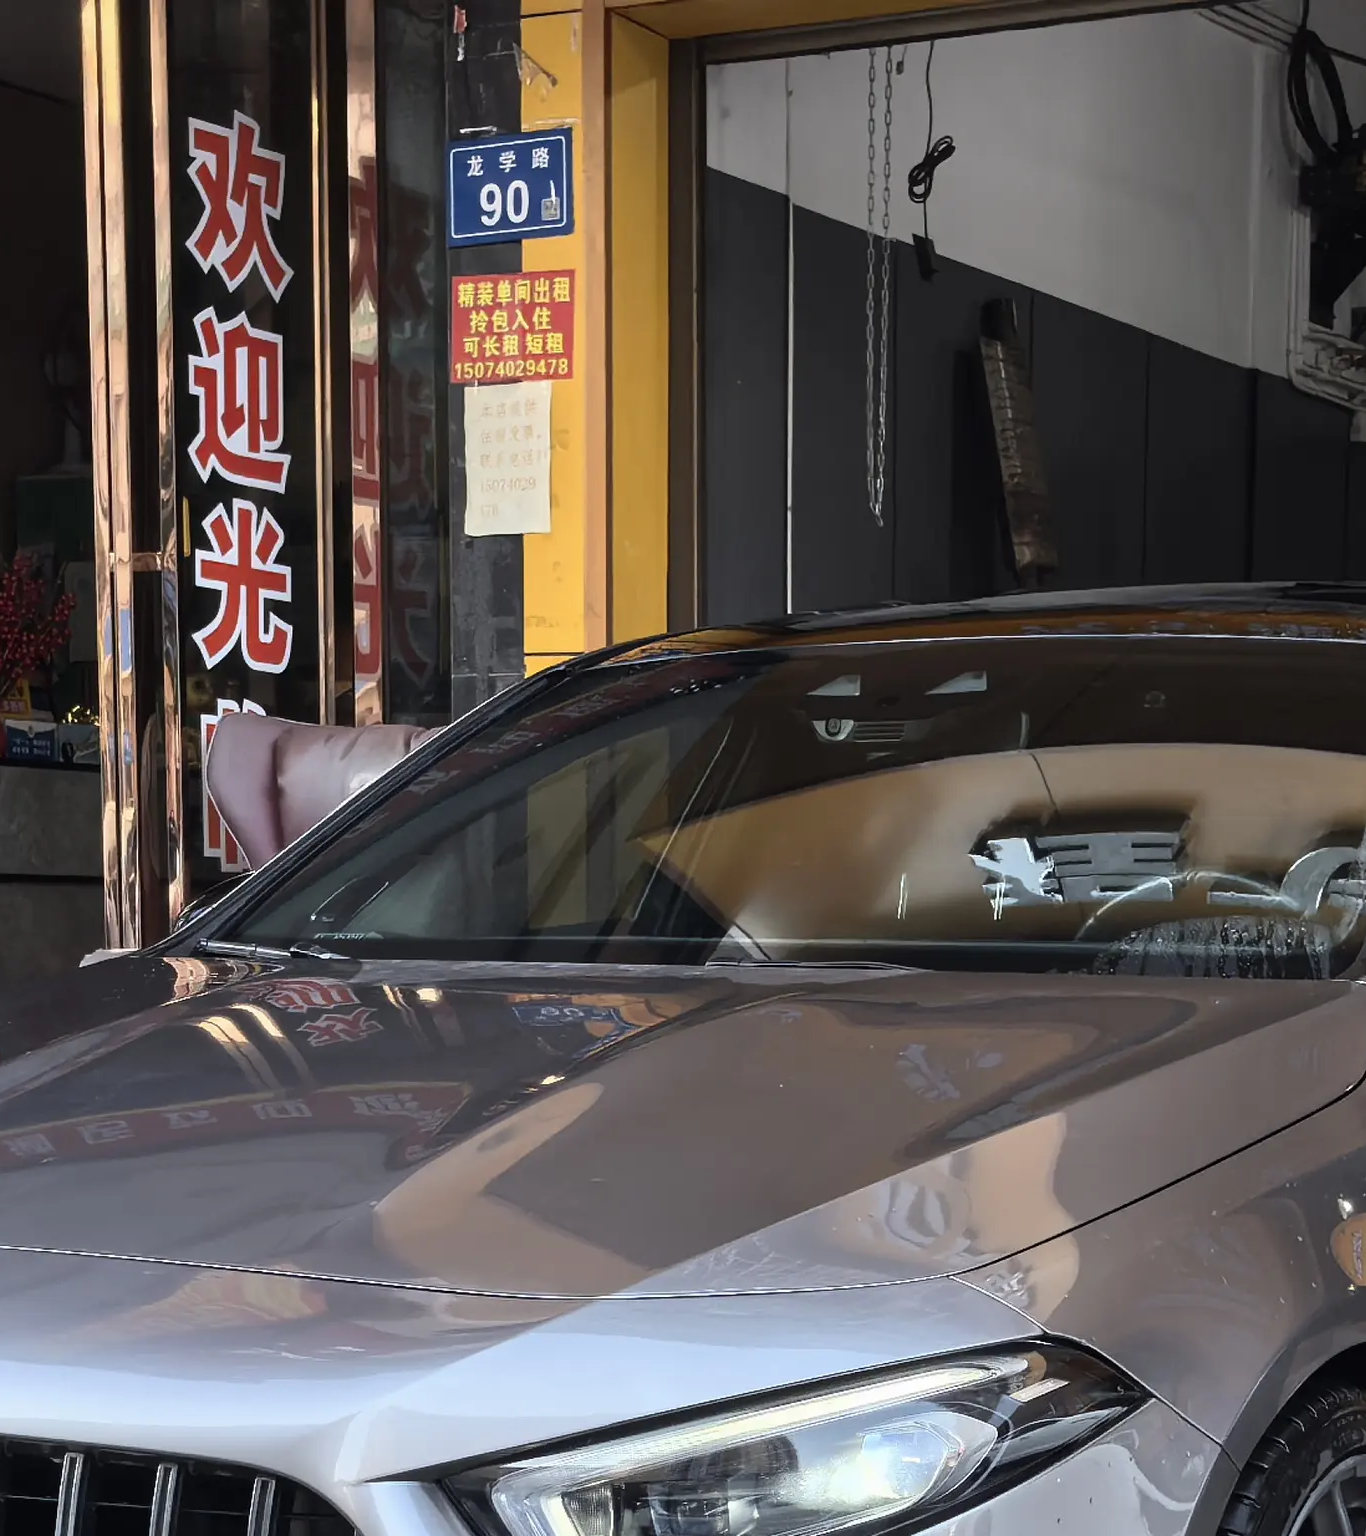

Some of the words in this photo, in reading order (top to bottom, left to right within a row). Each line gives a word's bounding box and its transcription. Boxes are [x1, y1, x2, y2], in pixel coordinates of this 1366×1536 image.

[467, 147, 550, 177] 龙学路
[480, 180, 529, 226] 90
[457, 276, 571, 308] 精装单间出租
[469, 307, 552, 335] 拎包入住
[463, 335, 520, 358] 可长租
[525, 332, 564, 355] 短租
[455, 358, 569, 380] 15074029478
[188, 110, 295, 870] 欢迎光
